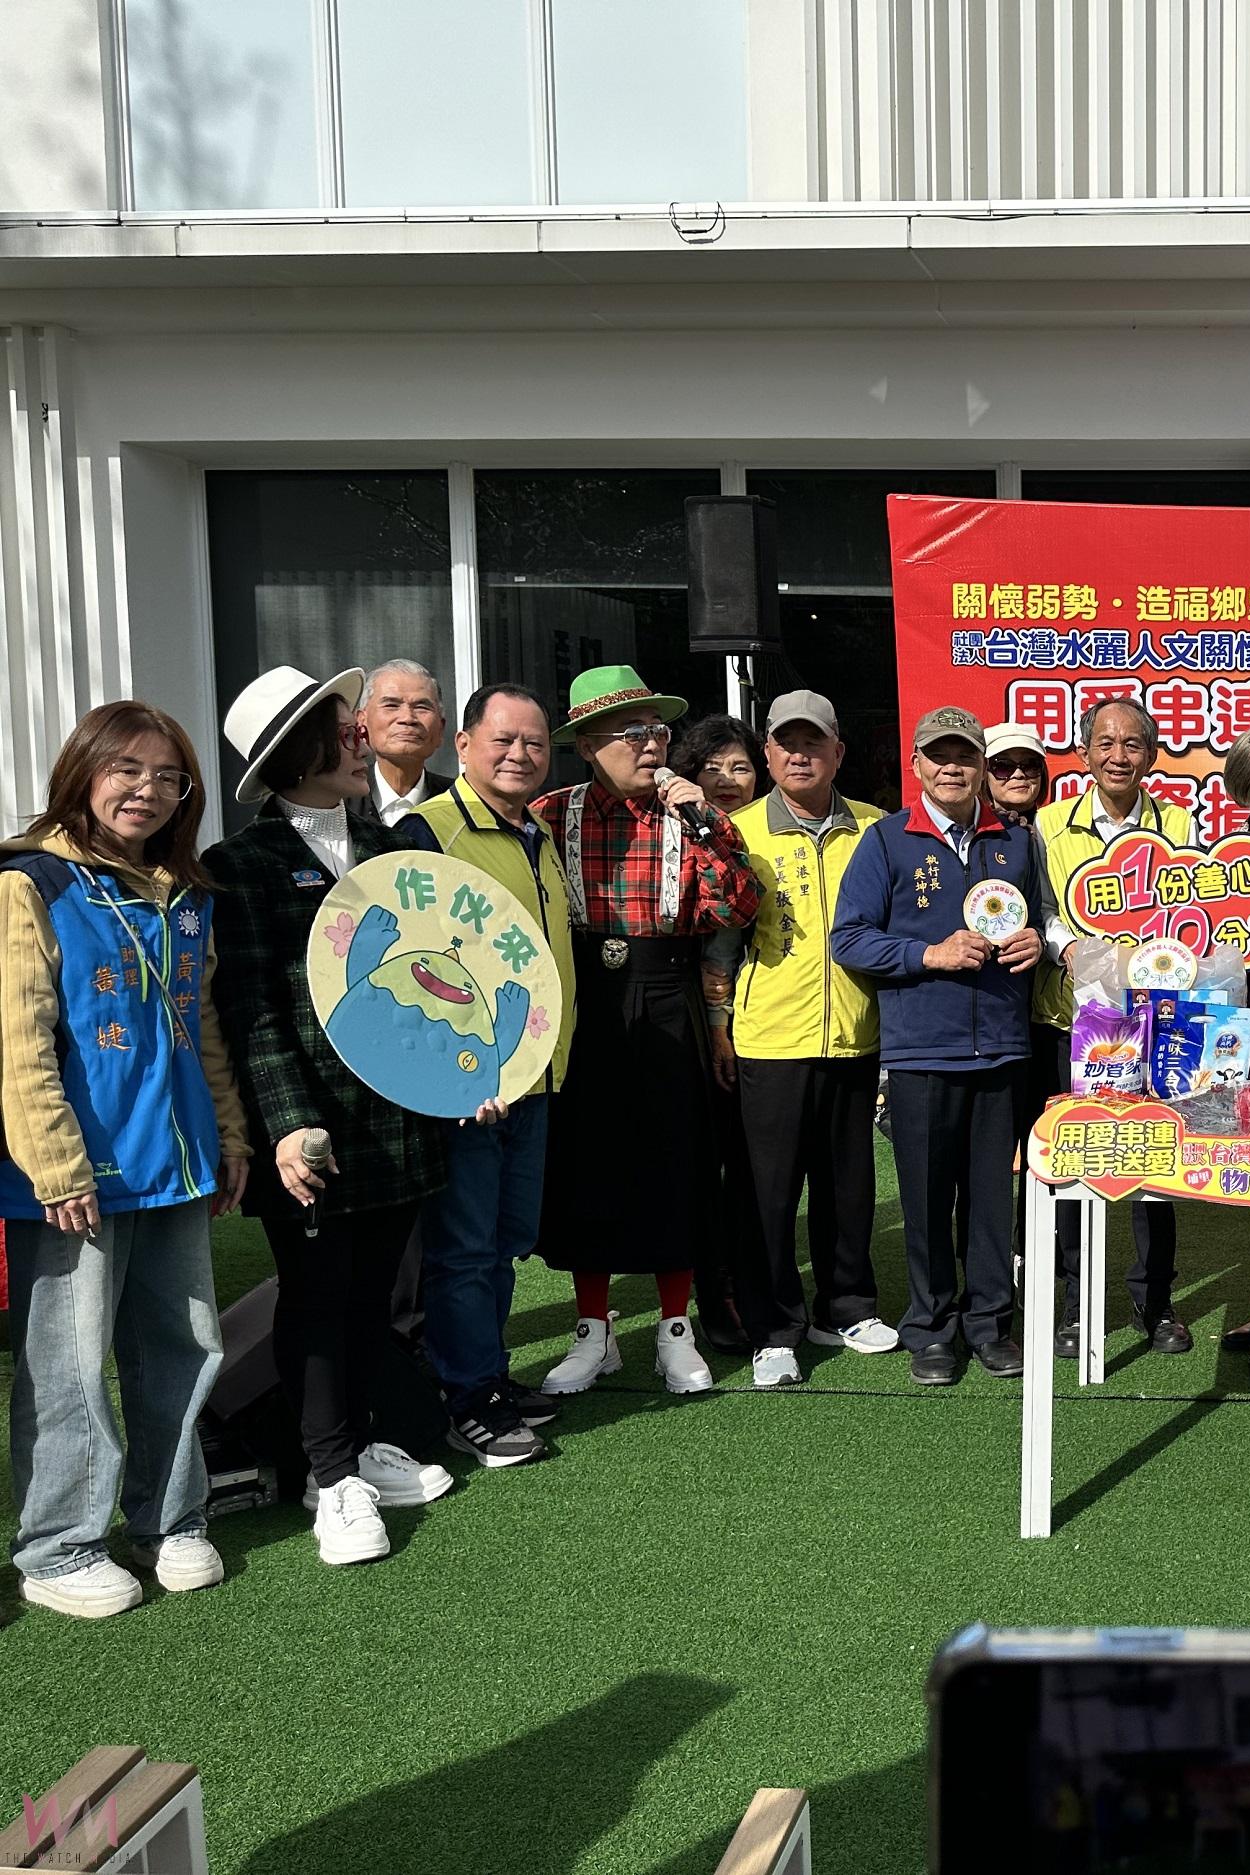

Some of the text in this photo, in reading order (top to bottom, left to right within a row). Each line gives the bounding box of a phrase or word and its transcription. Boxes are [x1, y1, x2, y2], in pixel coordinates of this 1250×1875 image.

[1057, 1120, 1176, 1149] 用愛串連
[1052, 1149, 1176, 1177] 攜手送愛
